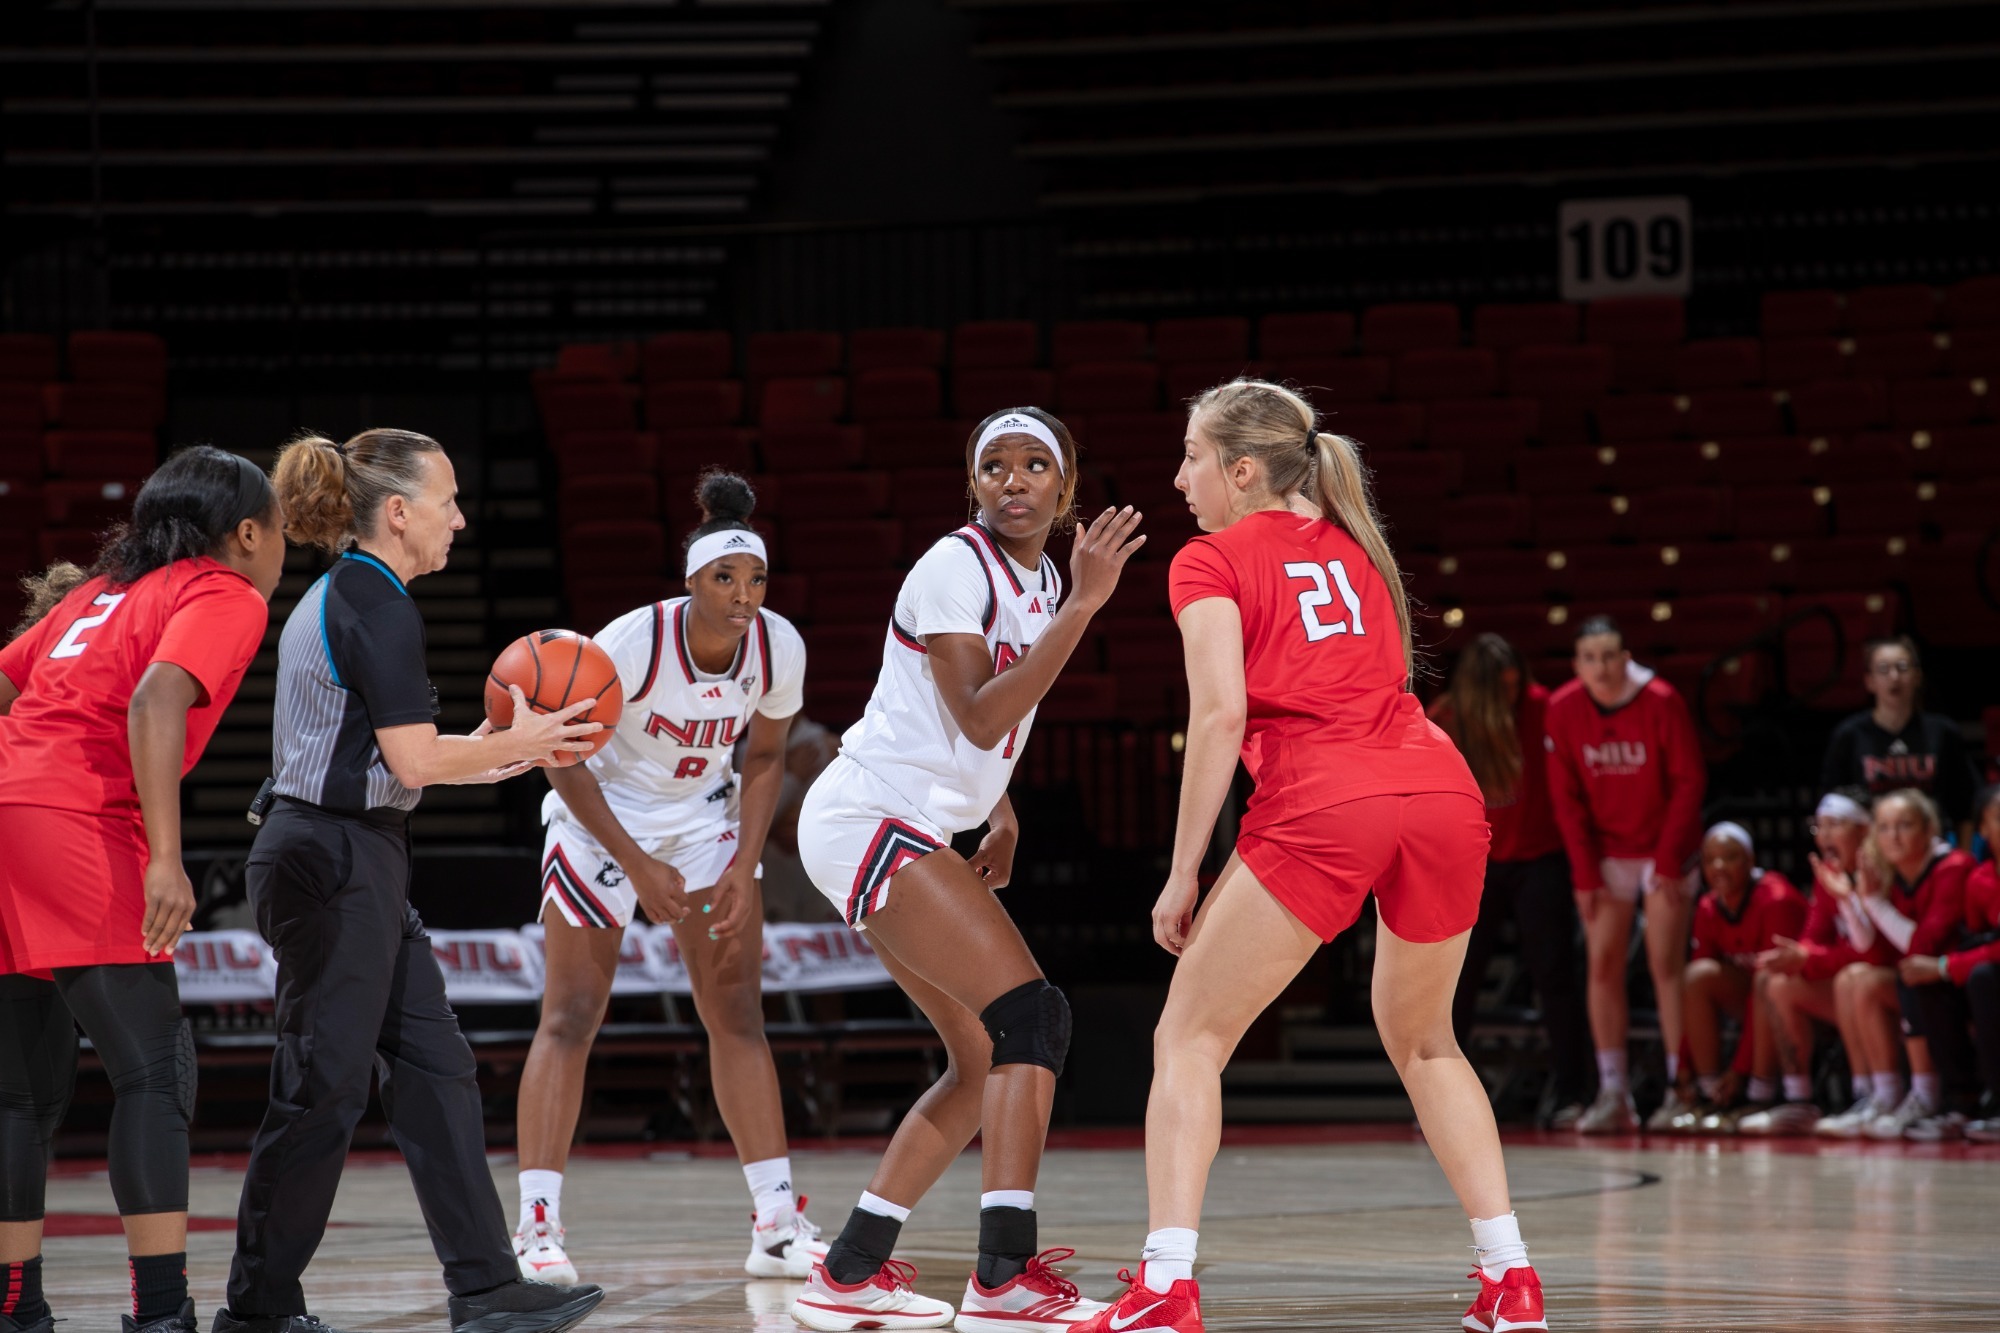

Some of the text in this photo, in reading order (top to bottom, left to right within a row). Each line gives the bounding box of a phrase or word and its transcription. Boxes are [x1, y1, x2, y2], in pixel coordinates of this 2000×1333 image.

[1570, 218, 1680, 280] 109
[993, 422, 1029, 431] adidas
[723, 542, 751, 550] adidas
[1283, 559, 1367, 643] 21
[47, 591, 127, 659] 2
[643, 710, 744, 748] NIU
[1582, 740, 1647, 768] NIU
[1861, 754, 1936, 782] NIU
